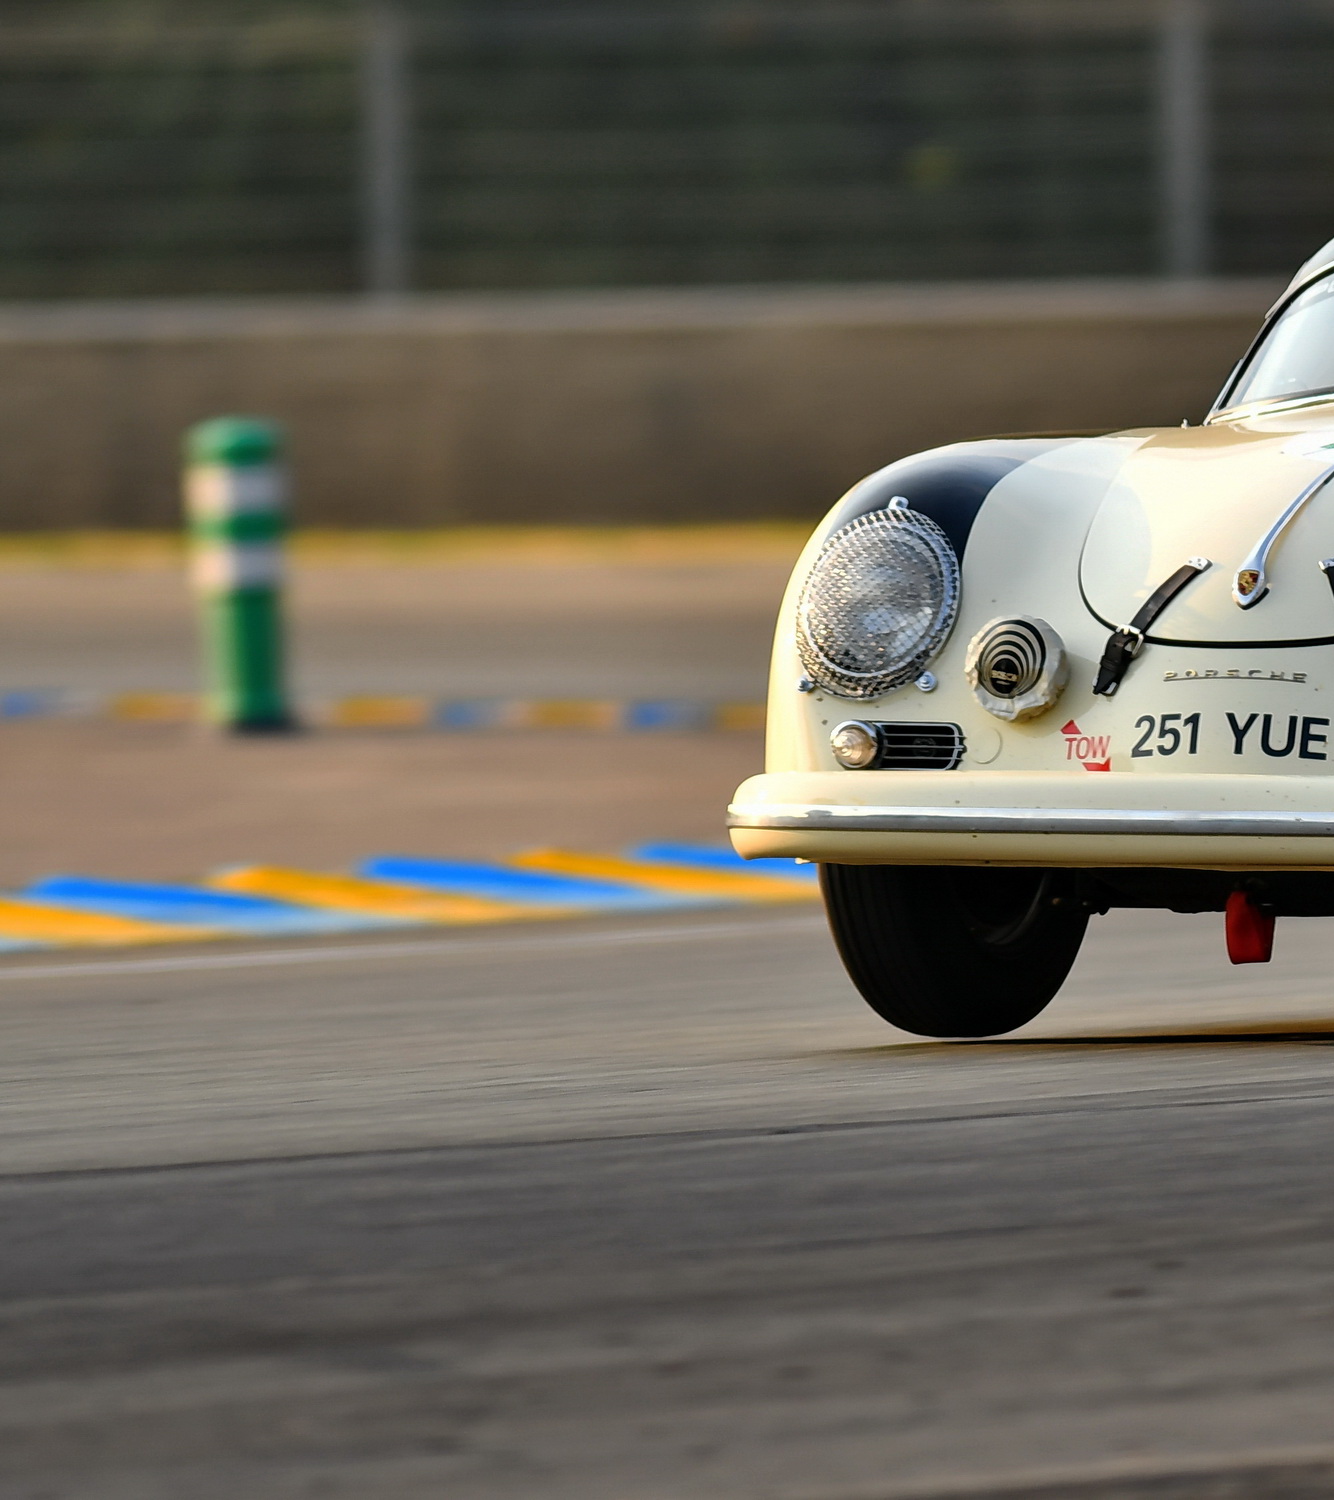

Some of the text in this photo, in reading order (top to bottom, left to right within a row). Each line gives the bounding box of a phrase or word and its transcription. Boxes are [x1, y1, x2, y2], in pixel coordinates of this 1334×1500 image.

[1064, 735, 1112, 760] TOW
[1131, 712, 1330, 760] 251 YUE
